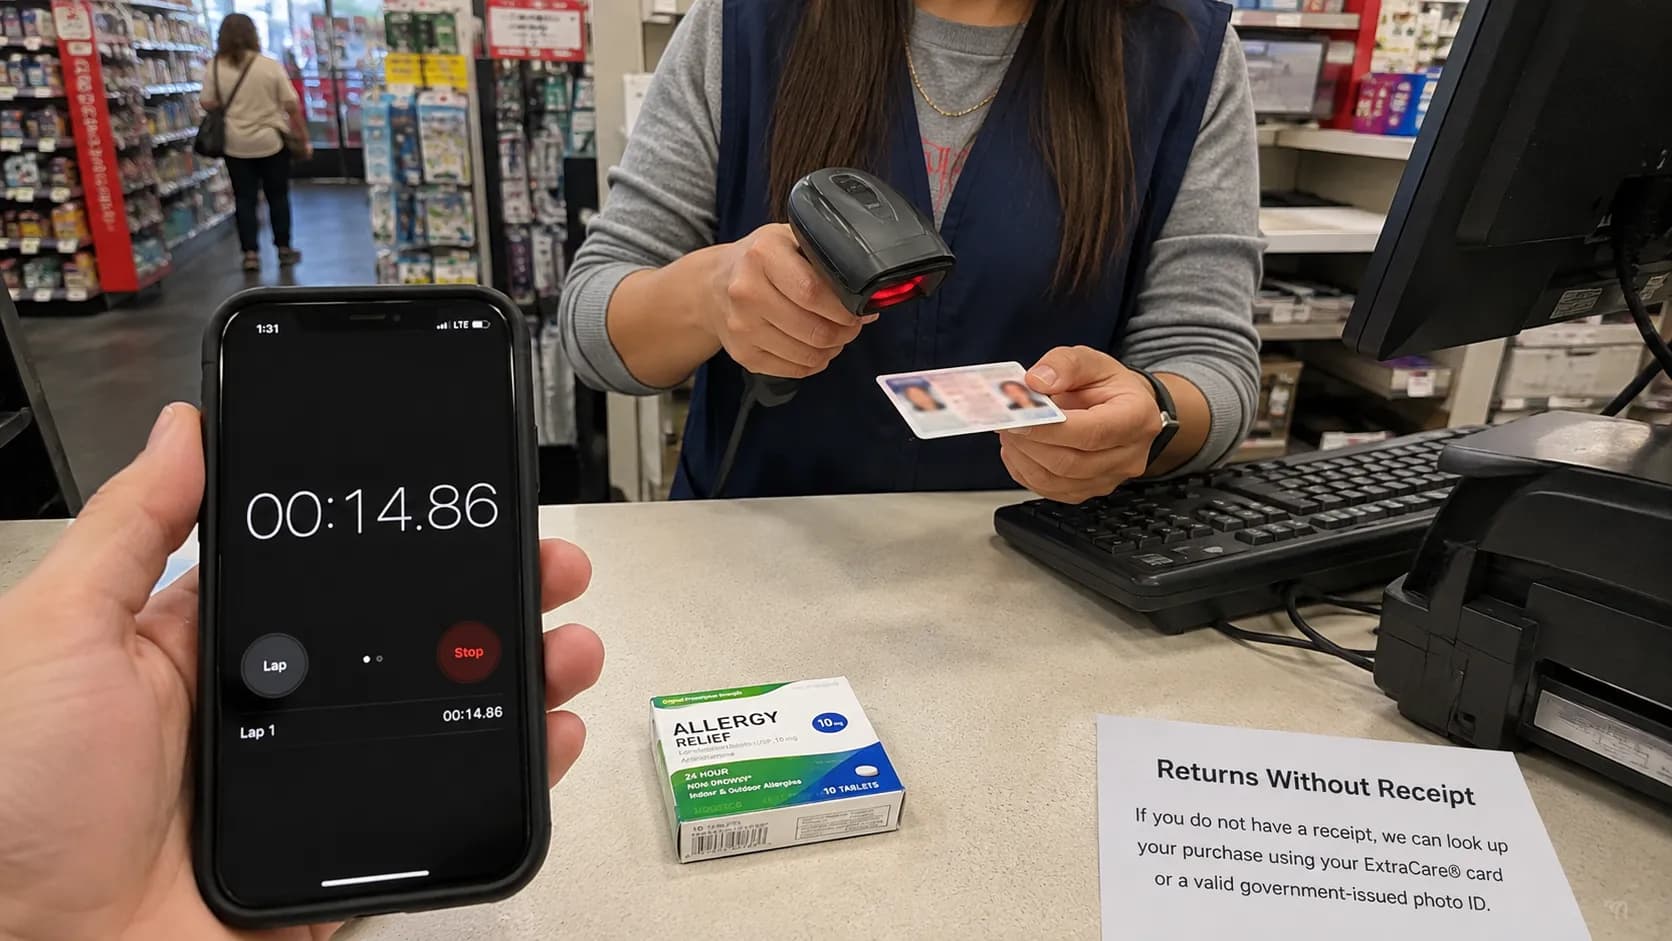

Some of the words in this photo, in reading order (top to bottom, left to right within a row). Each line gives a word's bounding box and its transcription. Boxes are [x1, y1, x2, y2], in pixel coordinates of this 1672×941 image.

[256, 324, 279, 334] 1:31
[453, 320, 469, 329] LTE
[247, 482, 498, 540] 00:14.86
[454, 647, 484, 660] Stop
[263, 660, 287, 673] Lap
[443, 706, 503, 722] 00:14.86
[673, 711, 778, 736] ALLERGY
[240, 726, 265, 740] Lap
[268, 724, 276, 737] 1
[676, 732, 731, 748] RELIEF
[699, 768, 729, 778] HOUR
[728, 783, 761, 794] Outdoor
[823, 786, 837, 796] 10
[838, 781, 880, 793] TABLETS
[1157, 758, 1259, 787] Returns
[1266, 768, 1371, 796] Without
[1378, 778, 1476, 809] Receipt
[1135, 807, 1147, 822] If
[1152, 812, 1184, 827] you
[1190, 812, 1212, 828] do
[1217, 817, 1246, 831] not
[1251, 817, 1292, 835] have
[1297, 824, 1308, 836] a
[1313, 825, 1377, 844] receipt,
[1382, 831, 1407, 845] we
[1411, 833, 1442, 848] can
[1447, 833, 1483, 851] look
[1487, 840, 1509, 856] up
[1137, 841, 1177, 857] your
[1183, 844, 1263, 863] purchase
[1268, 850, 1315, 870] using
[1320, 855, 1358, 871] your
[1364, 857, 1461, 879] ExtraCare®
[1466, 867, 1504, 882] card
[1154, 874, 1172, 886] or
[1178, 876, 1188, 888] a
[1193, 875, 1234, 892] valid
[1240, 880, 1408, 906] government-issued
[1413, 891, 1463, 910] photo
[1468, 895, 1491, 912] ID.
